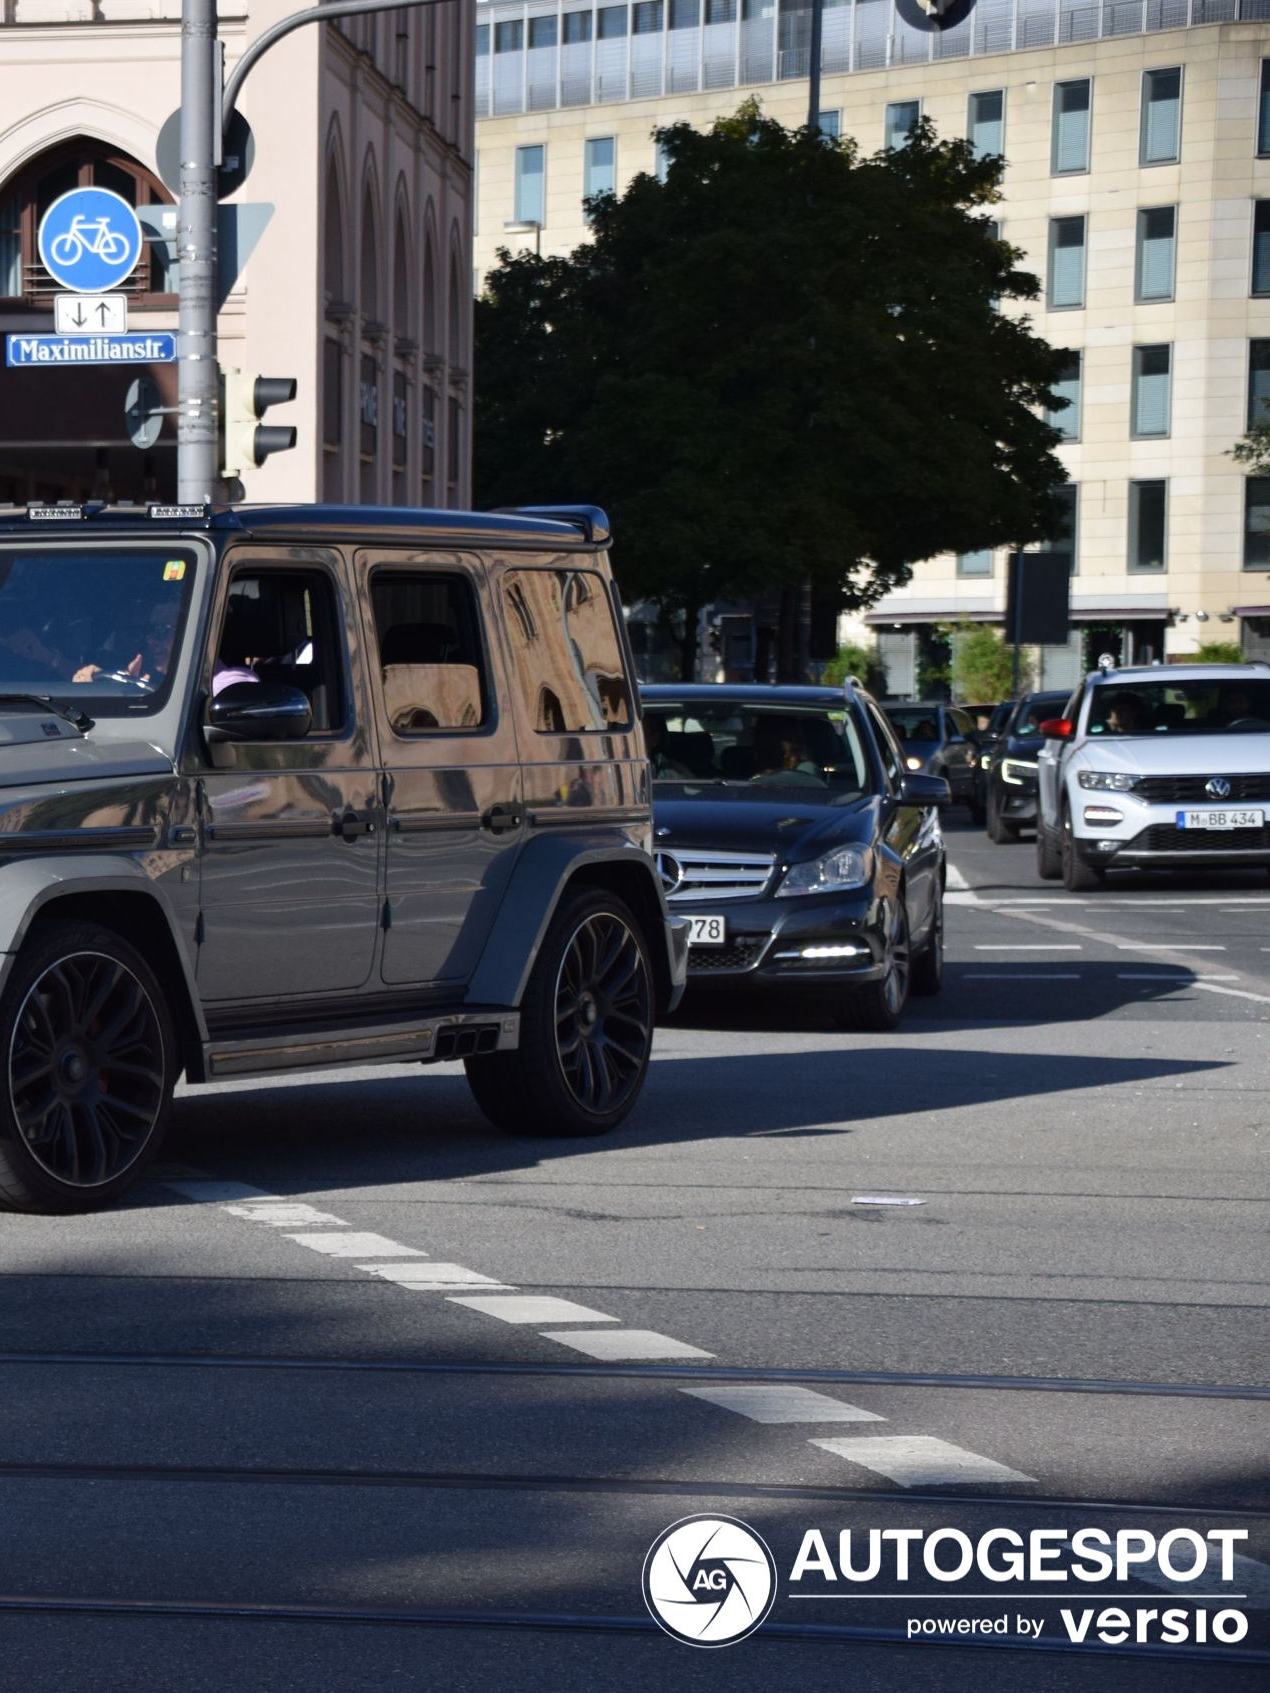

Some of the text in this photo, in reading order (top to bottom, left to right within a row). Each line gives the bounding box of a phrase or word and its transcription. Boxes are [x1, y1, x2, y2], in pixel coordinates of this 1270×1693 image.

[20, 338, 166, 362] Maximilianstr.
[1190, 812, 1256, 826] M BB 434
[688, 919, 720, 939] 78
